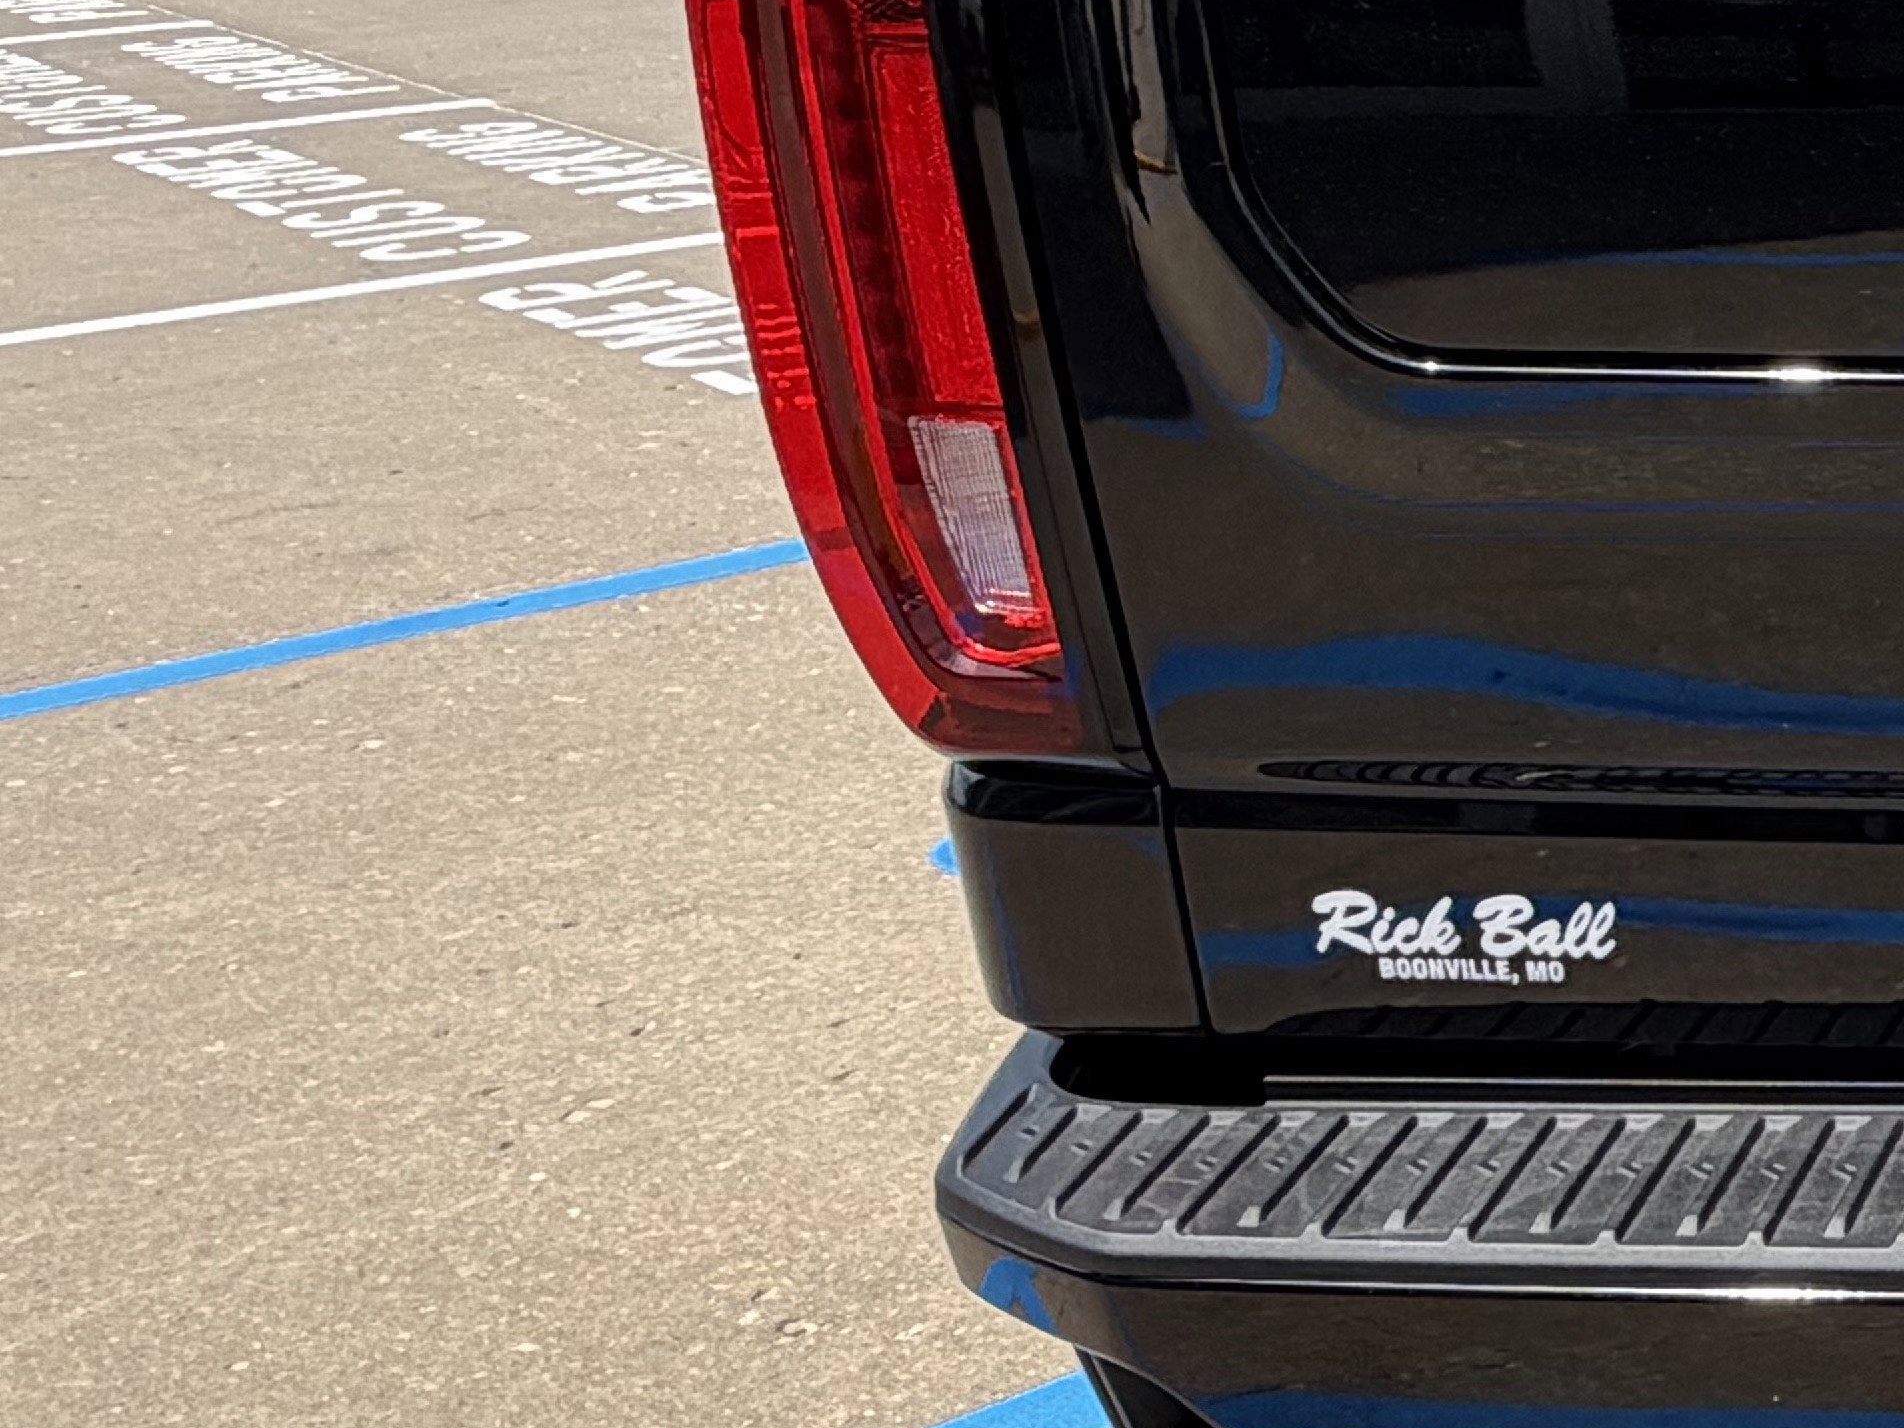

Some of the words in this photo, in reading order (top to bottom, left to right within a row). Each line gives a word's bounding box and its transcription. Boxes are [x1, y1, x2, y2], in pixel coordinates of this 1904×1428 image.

[113, 139, 531, 262] CUSTOMER
[1311, 890, 1462, 955] Rick
[1472, 894, 1617, 959] Ball
[1378, 957, 1520, 985] BOONVILLE,
[1525, 961, 1565, 982] MO
